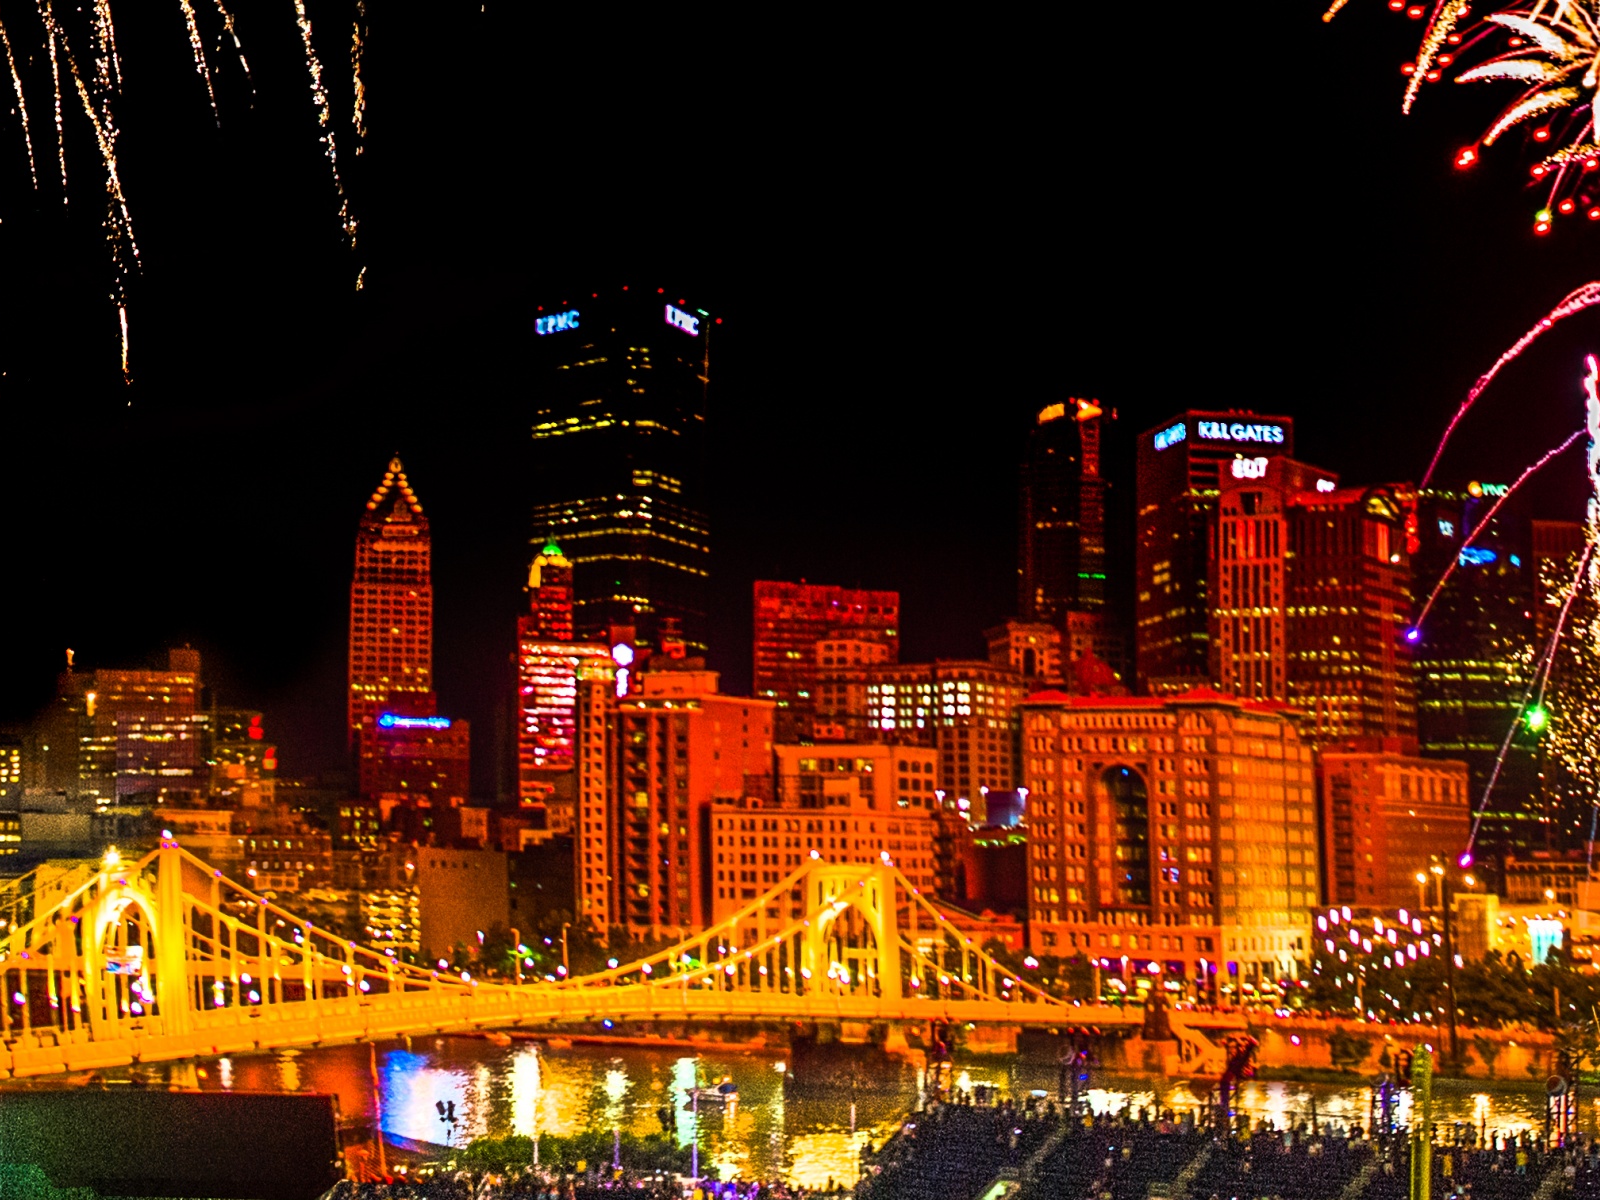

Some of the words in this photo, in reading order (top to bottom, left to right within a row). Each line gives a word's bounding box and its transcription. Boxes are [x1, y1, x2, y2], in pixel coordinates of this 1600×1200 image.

[535, 310, 579, 335] UPMC
[1198, 421, 1230, 440] K&L
[1230, 423, 1284, 444] GATES
